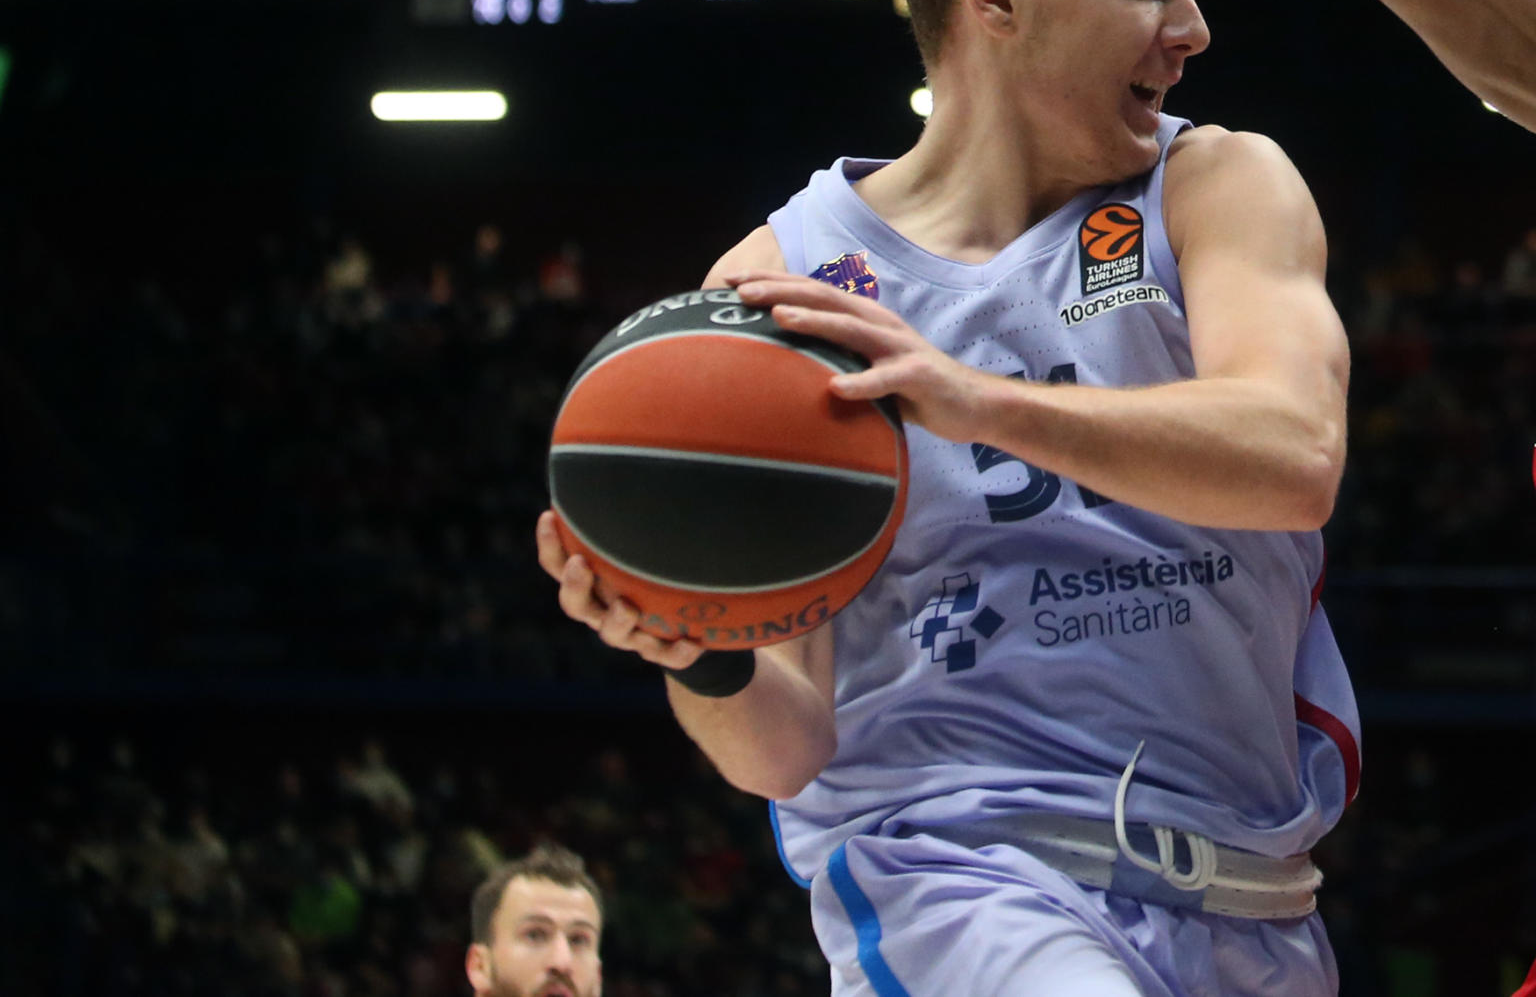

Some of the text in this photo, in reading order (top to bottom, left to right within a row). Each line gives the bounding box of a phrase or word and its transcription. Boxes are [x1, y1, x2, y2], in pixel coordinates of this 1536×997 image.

[1086, 254, 1138, 275] TURKISH
[1086, 263, 1138, 285] AIRLINES
[1086, 272, 1138, 292] EuroLeague
[1034, 591, 1191, 647] Sanitària
